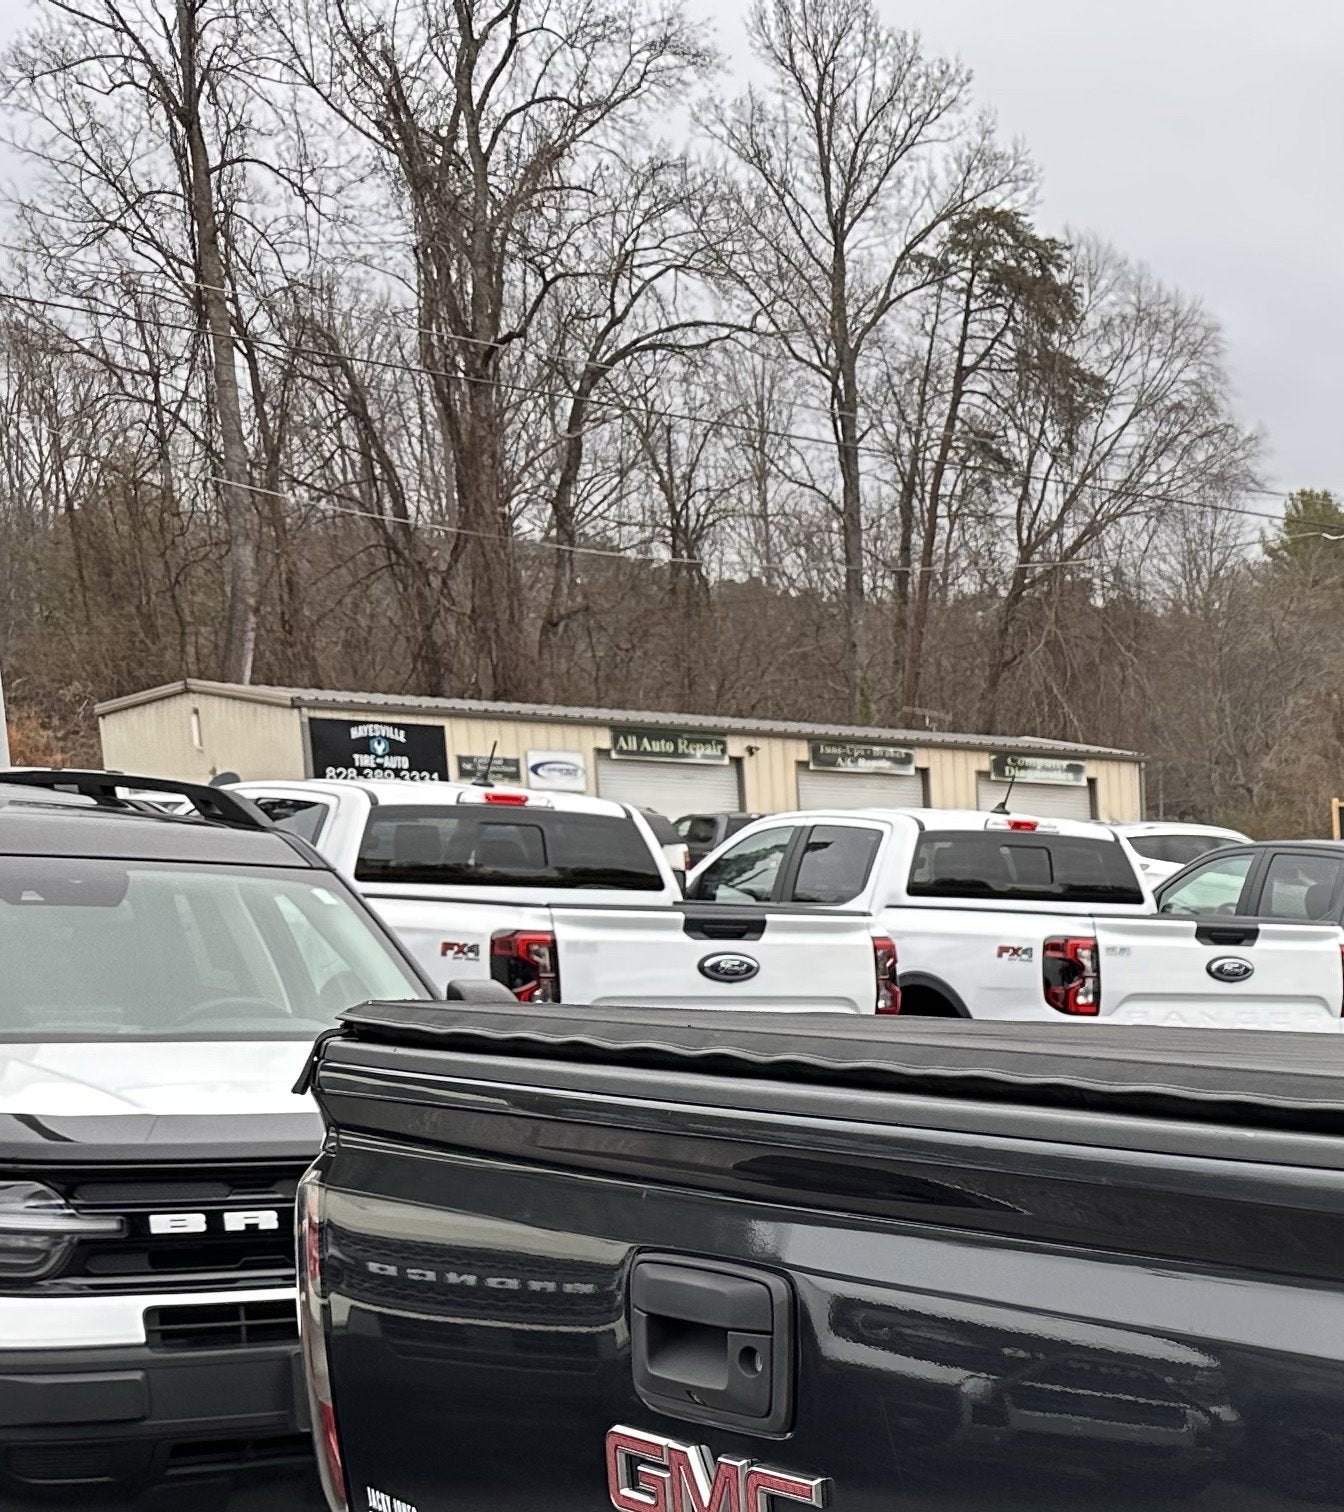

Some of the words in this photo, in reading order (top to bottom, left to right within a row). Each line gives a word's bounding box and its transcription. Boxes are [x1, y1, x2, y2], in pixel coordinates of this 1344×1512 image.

[350, 724, 407, 743] HAYESVILLE
[616, 735, 638, 751] All
[640, 737, 674, 753] Auto
[677, 738, 724, 756] Repair
[352, 754, 376, 768] TIRE
[383, 755, 409, 769] AUTO
[441, 942, 480, 957] FX4
[997, 946, 1033, 958] FX4
